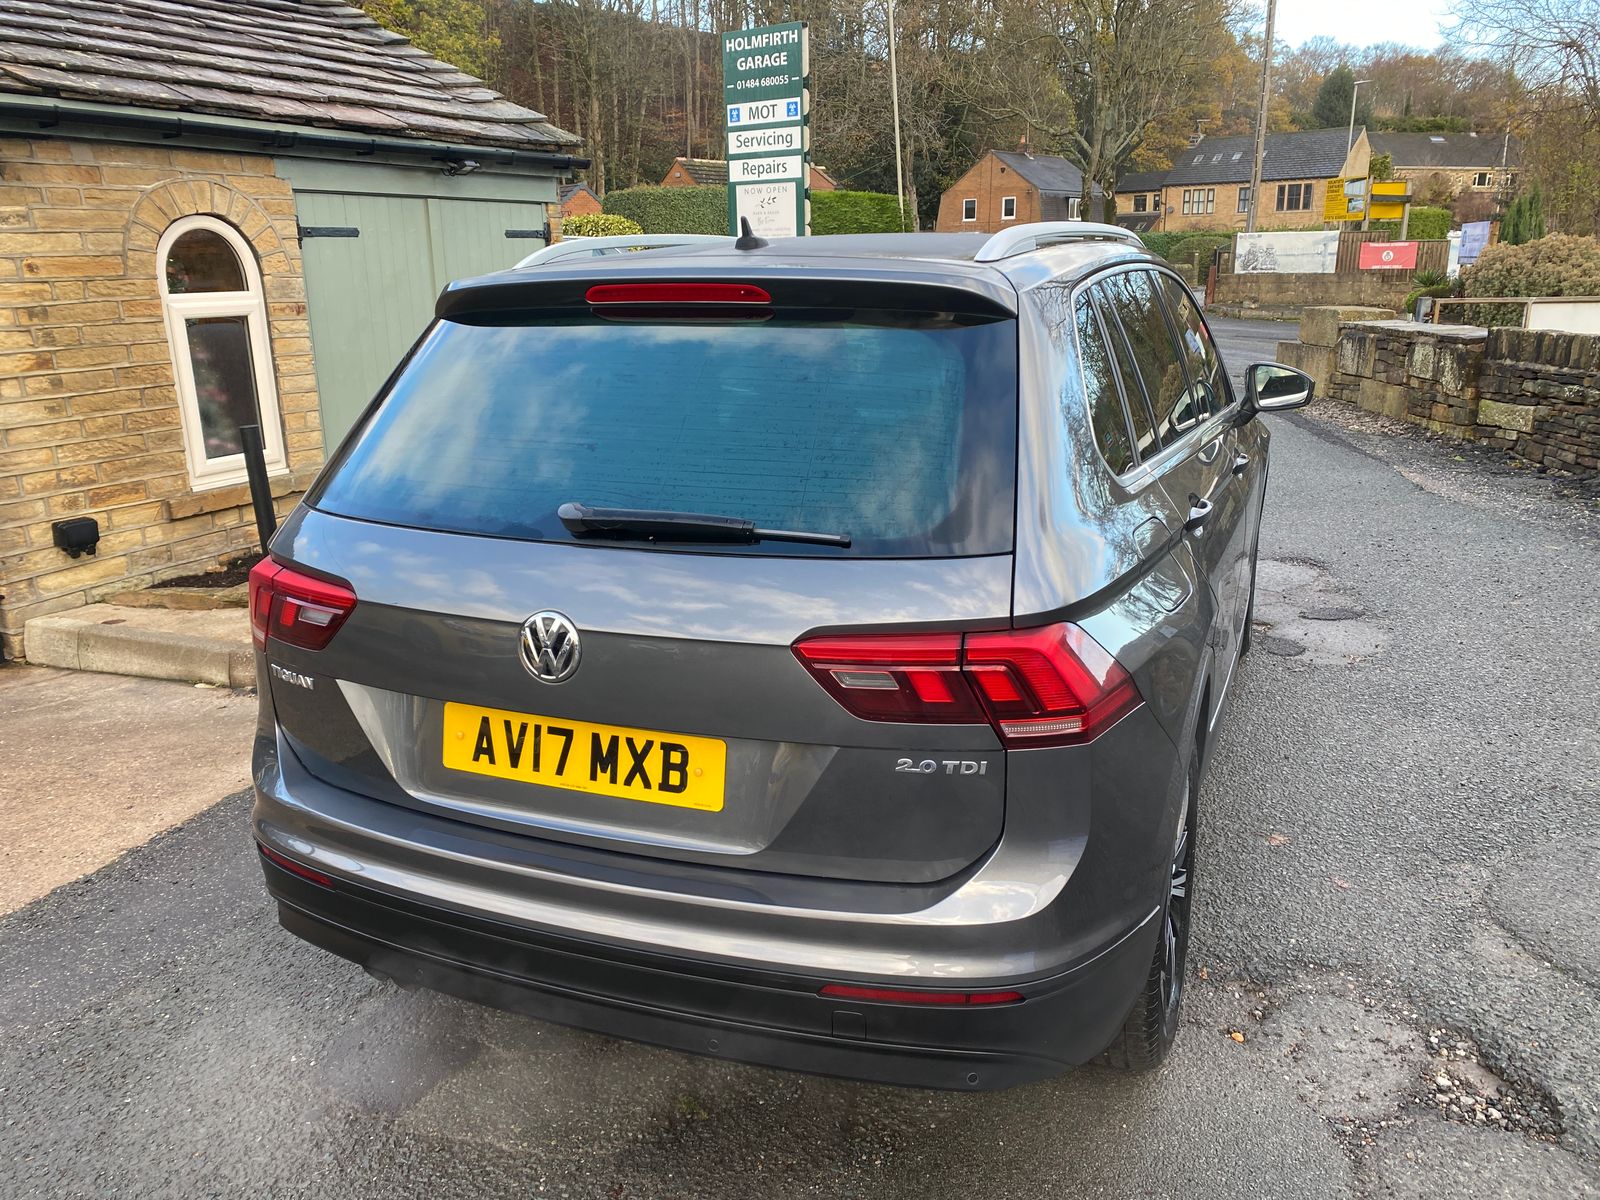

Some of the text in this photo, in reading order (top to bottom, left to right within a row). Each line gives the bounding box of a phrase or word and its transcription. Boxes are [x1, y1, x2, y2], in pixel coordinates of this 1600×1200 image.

[726, 29, 798, 52] HOLMFIRTH
[736, 52, 788, 71] GARAGE
[736, 75, 789, 90] 01484 680055
[748, 104, 778, 121] MOT
[736, 131, 793, 149] Servicing
[742, 160, 788, 178] Repairs
[744, 186, 788, 195] NOW OPEN
[472, 716, 689, 794] AV17 MXB
[895, 758, 988, 775] 2.0 TDI
